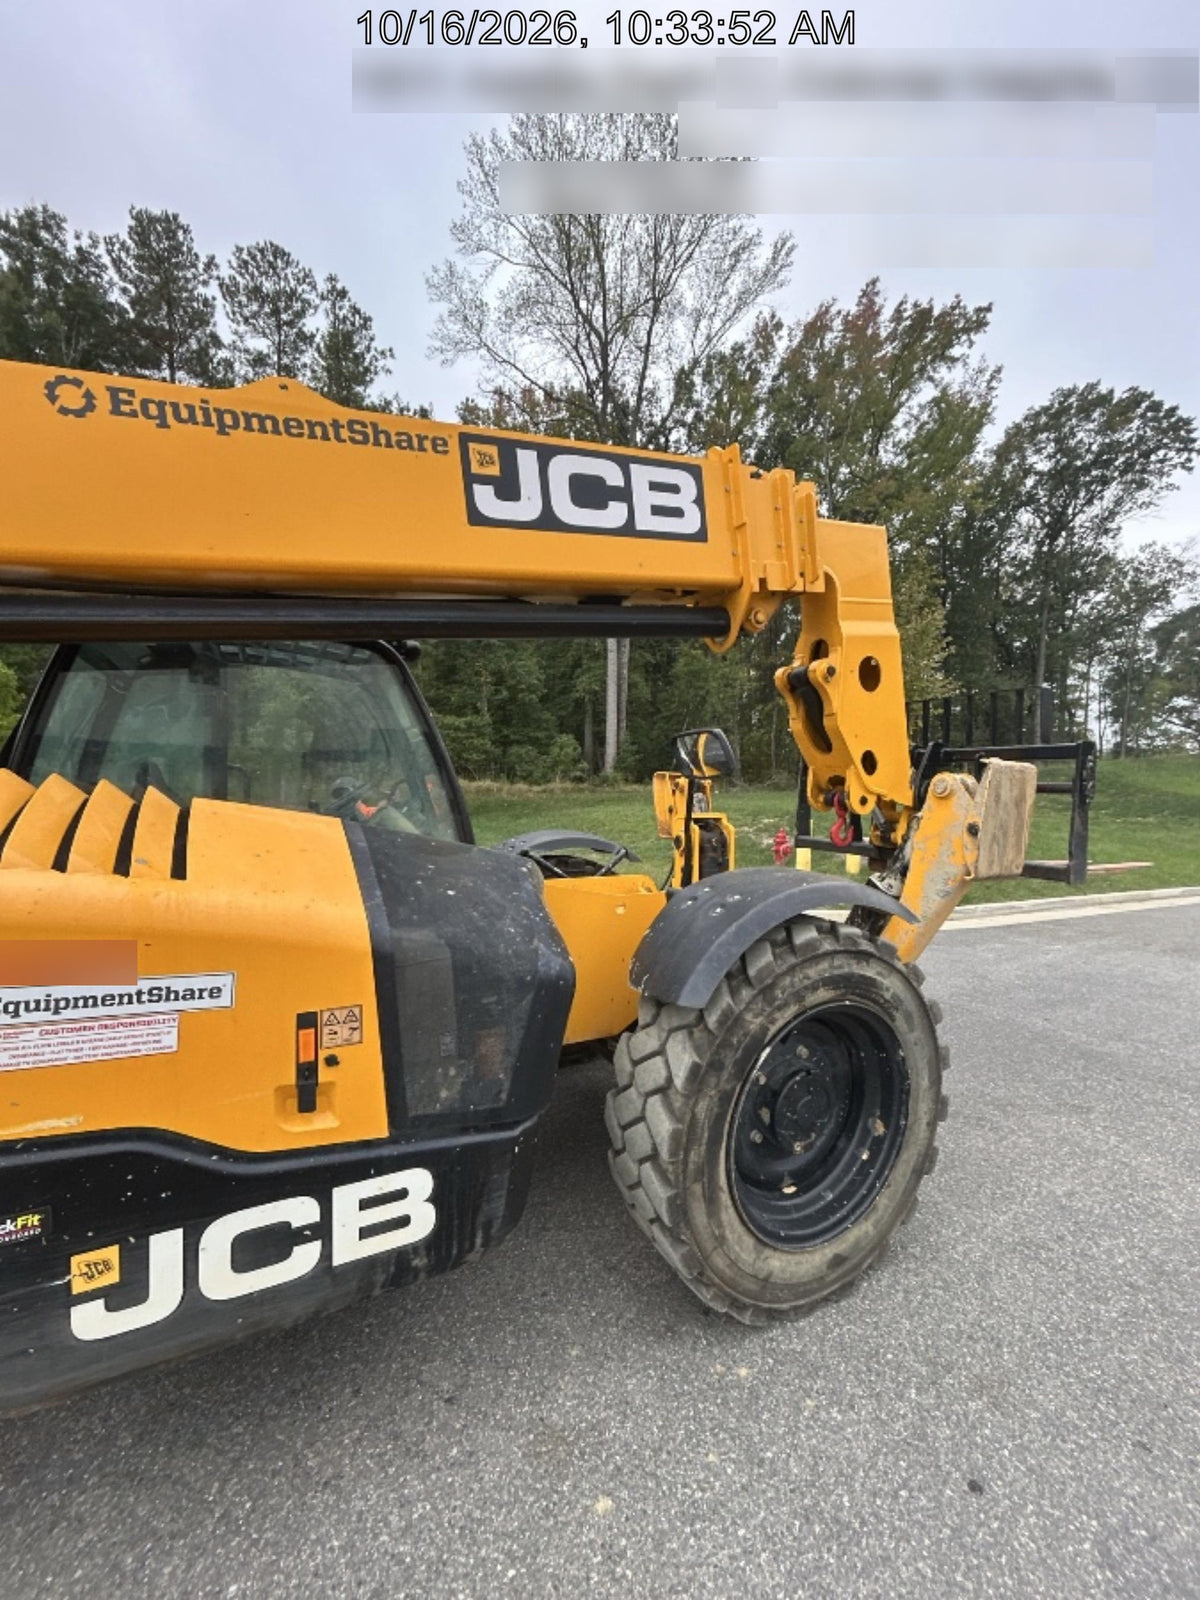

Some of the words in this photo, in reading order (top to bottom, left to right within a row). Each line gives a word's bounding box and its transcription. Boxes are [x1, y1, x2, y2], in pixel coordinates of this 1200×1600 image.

[106, 385, 450, 456] EquipmentShare
[472, 448, 703, 535] JCB
[0, 984, 223, 1019] quipmentShare
[70, 1167, 437, 1341] JCB
[82, 1260, 111, 1280] JCB
